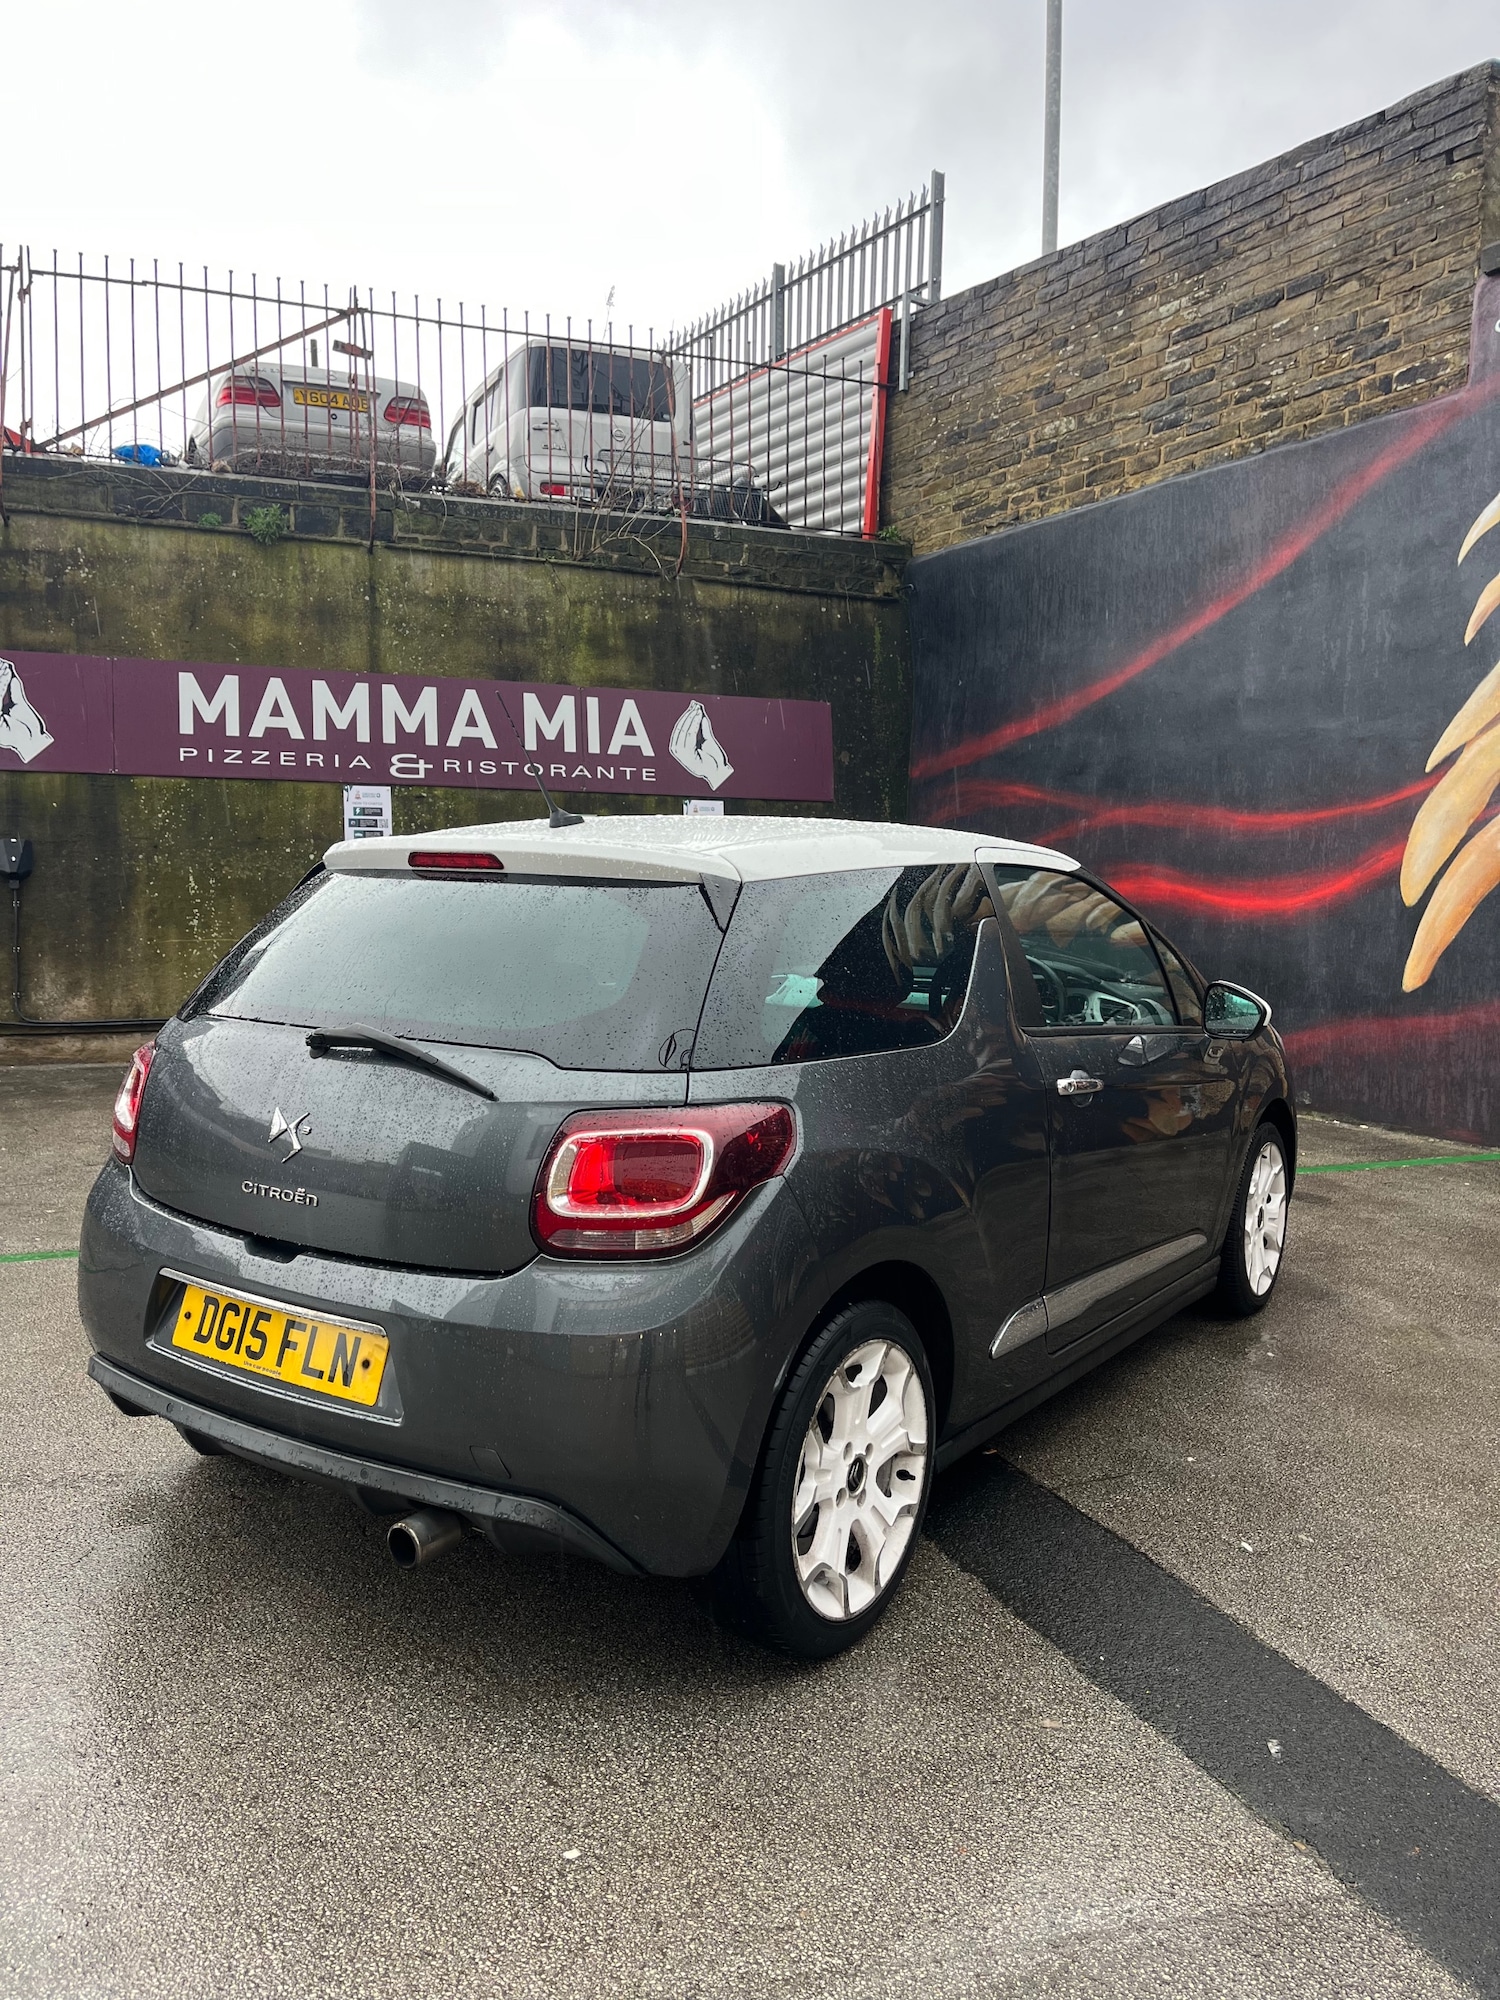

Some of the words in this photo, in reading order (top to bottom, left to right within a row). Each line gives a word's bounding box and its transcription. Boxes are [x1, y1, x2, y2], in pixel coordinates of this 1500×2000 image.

[178, 671, 499, 749] MAMMA
[522, 692, 655, 757] MIA
[179, 748, 371, 769] PIZZERIA
[389, 753, 433, 779] &
[443, 759, 657, 781] RISTORANTE
[193, 1295, 272, 1361] DG15
[275, 1318, 361, 1388] FLN
